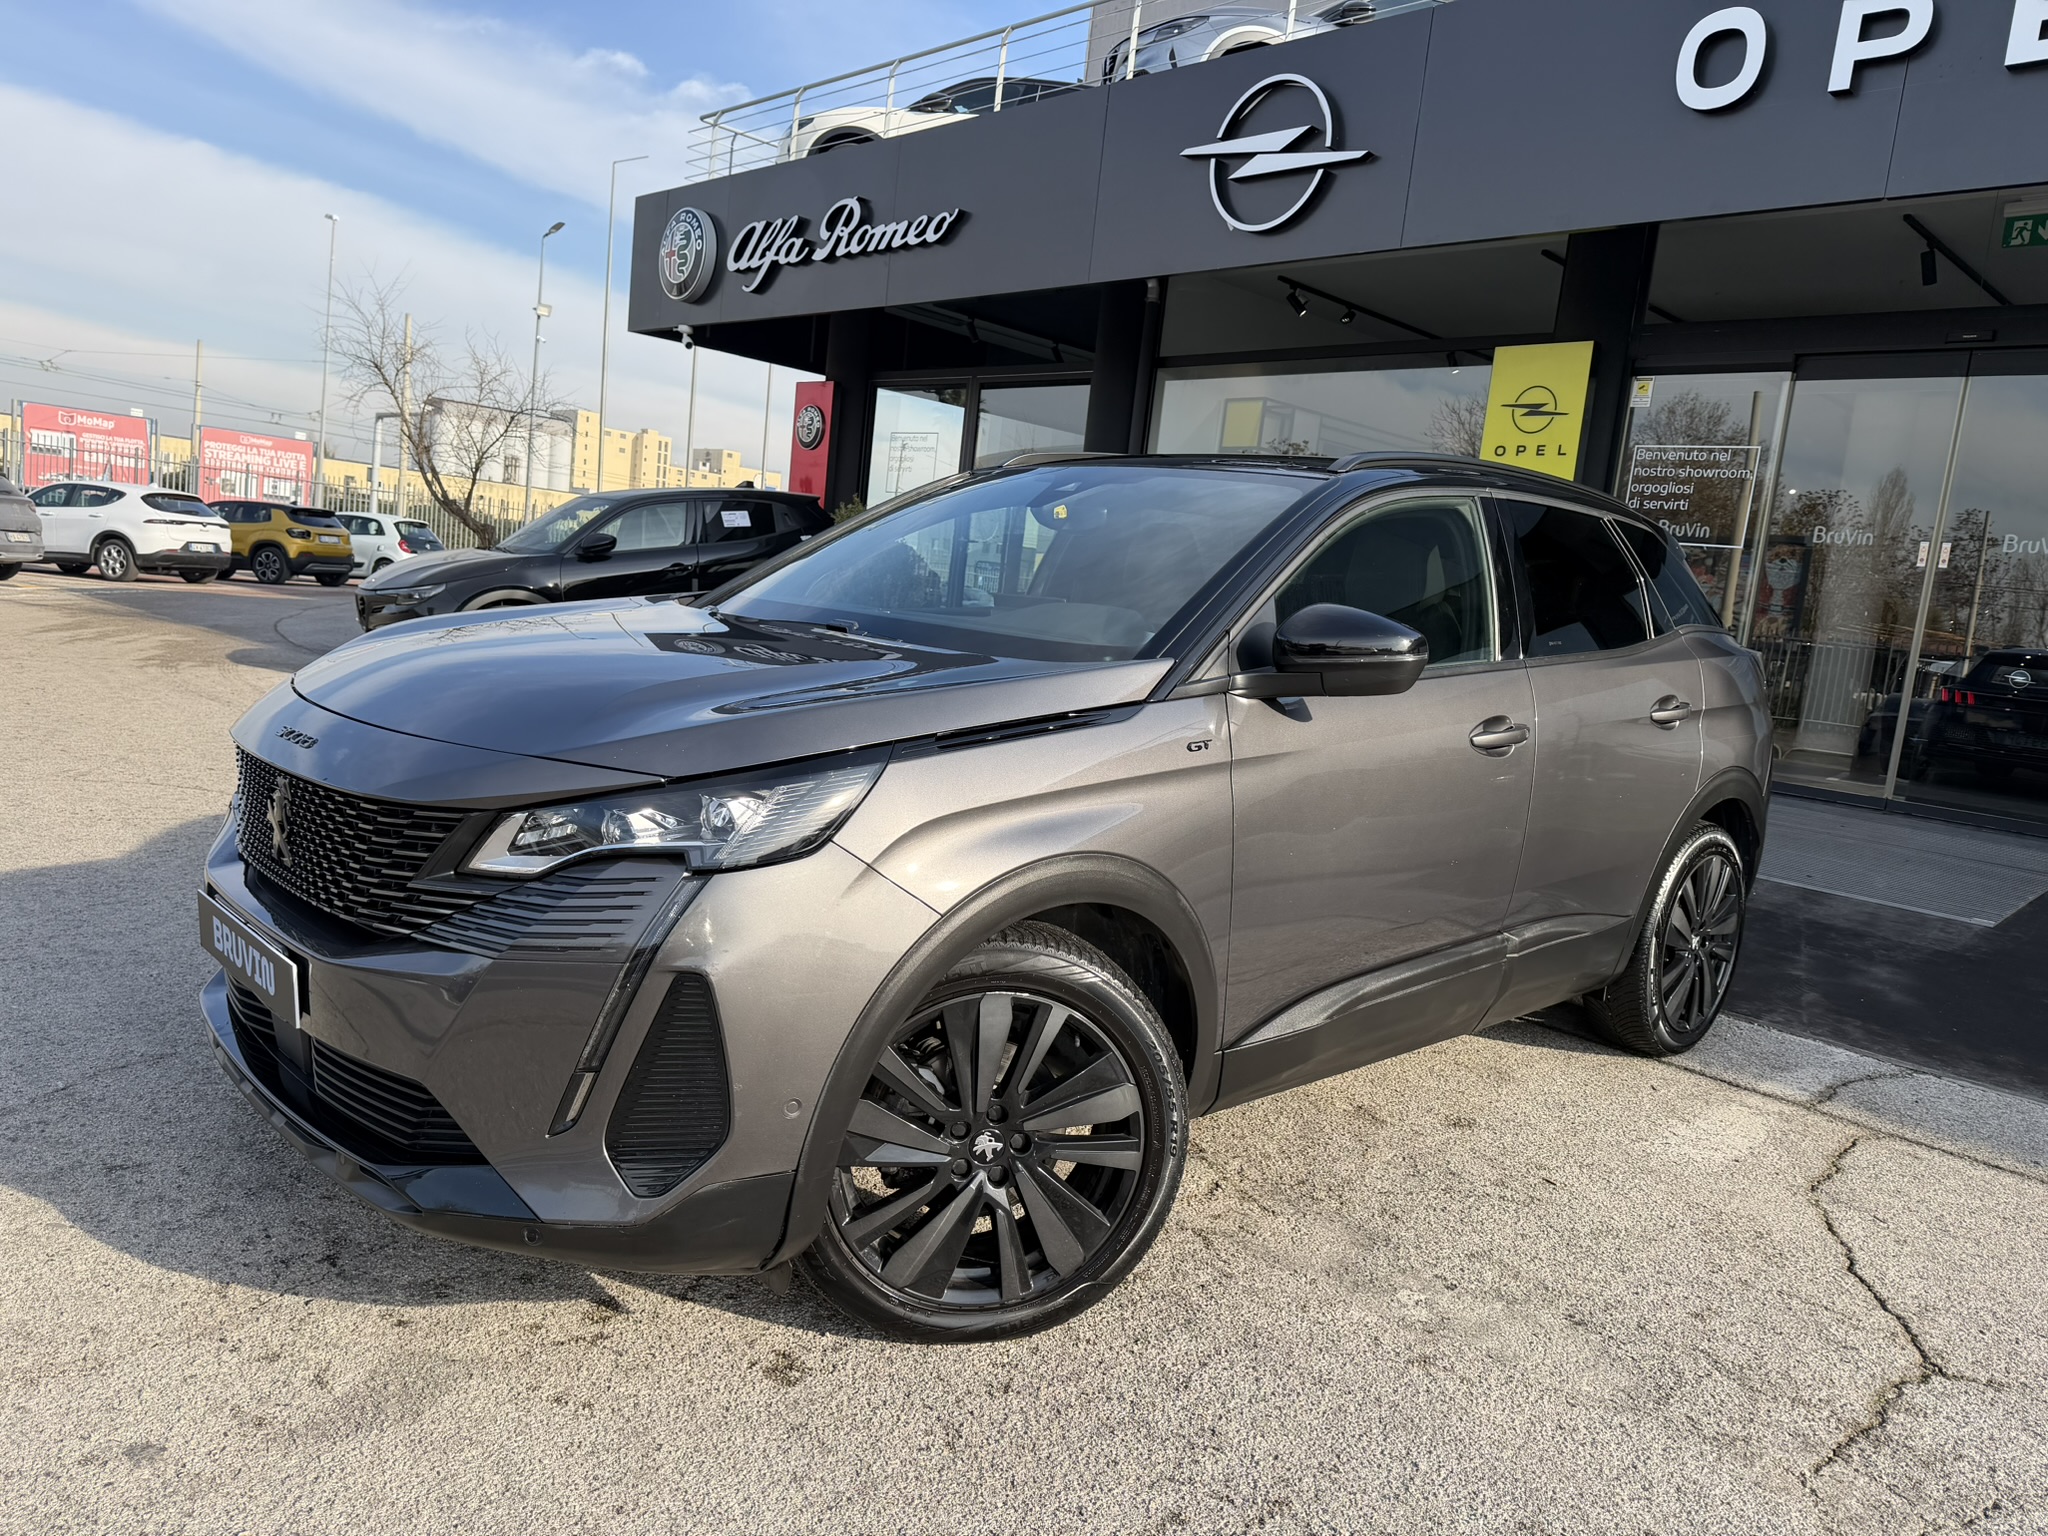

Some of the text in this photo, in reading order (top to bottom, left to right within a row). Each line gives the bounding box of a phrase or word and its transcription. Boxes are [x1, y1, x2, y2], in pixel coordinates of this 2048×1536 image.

[680, 212, 703, 250] ROMEO
[727, 195, 960, 292] Alfa Romeo
[77, 414, 115, 430] MoMap
[204, 440, 307, 461] PROTEGGI LA TUA FLOTTA
[1494, 444, 1567, 457] OPEL
[1636, 448, 1731, 461] Benvenuto nel
[204, 448, 271, 466] STREAMING
[273, 457, 298, 470] LIVE
[299, 461, 307, 471] E
[1634, 465, 1754, 480] nostro showroom,
[1631, 481, 1695, 496] orgogliosi
[1629, 497, 1689, 511] di servirti
[1812, 525, 1874, 546] BruVin
[1186, 739, 1213, 752] GT
[212, 915, 276, 996] BRUVIN
